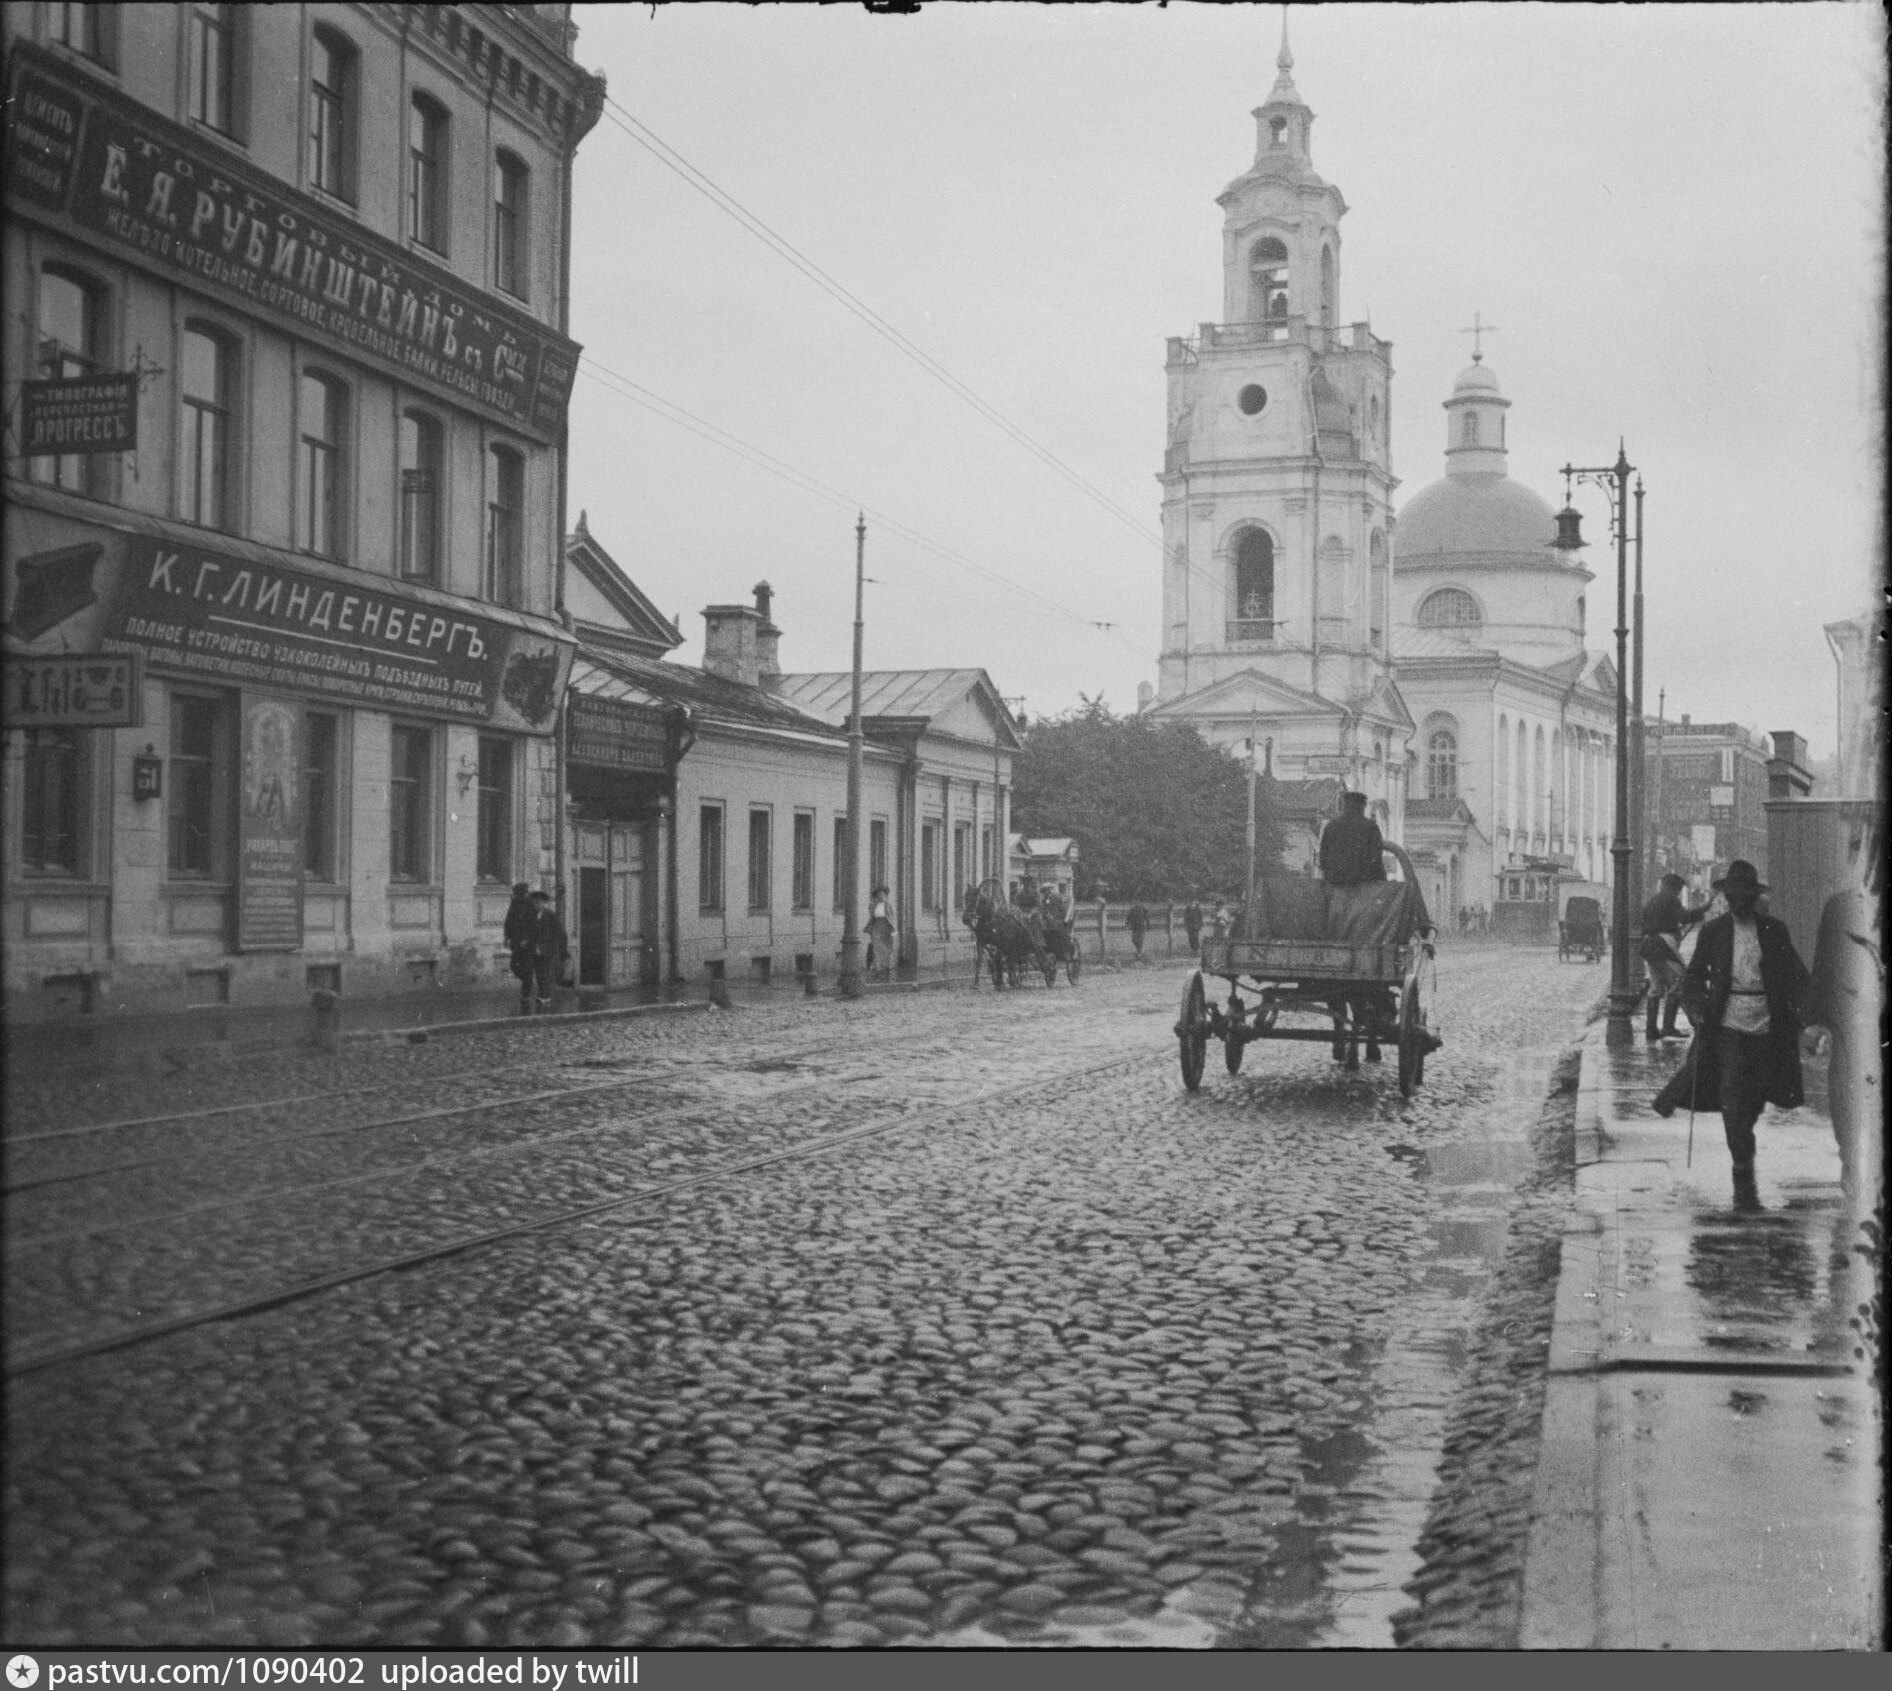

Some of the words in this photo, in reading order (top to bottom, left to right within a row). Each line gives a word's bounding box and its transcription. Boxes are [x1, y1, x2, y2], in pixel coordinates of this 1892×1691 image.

[147, 171, 177, 229] Я.
[190, 190, 457, 359] РУБИНШТЕЙНЪ
[148, 551, 182, 594] К.
[126, 617, 184, 643] ПОЛНОЕ
[188, 628, 270, 658] УСТРОЙСТВО
[274, 644, 371, 677] УЗКОКОЛЕЙНЫХЪ
